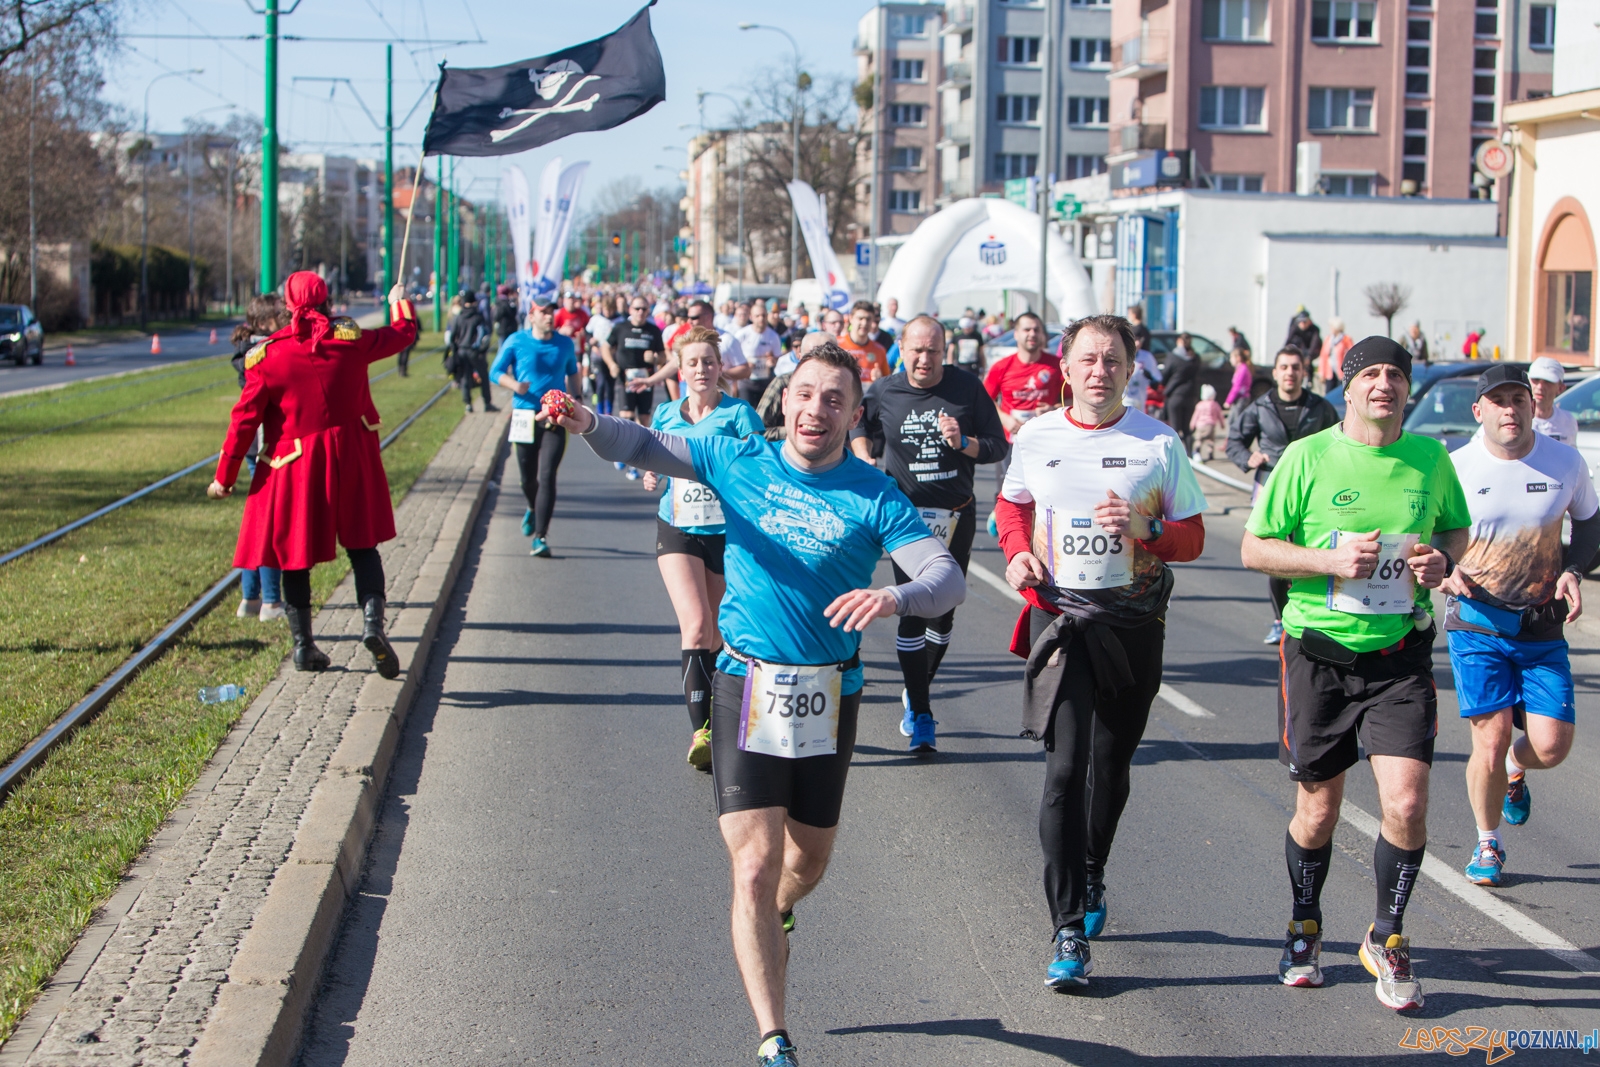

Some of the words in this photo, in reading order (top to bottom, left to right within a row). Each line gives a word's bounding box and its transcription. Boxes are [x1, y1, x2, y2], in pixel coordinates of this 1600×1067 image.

[916, 469, 958, 482] TRIATHLON
[1062, 534, 1123, 556] 8203
[766, 691, 826, 718] 7380
[789, 721, 804, 729] Piotr
